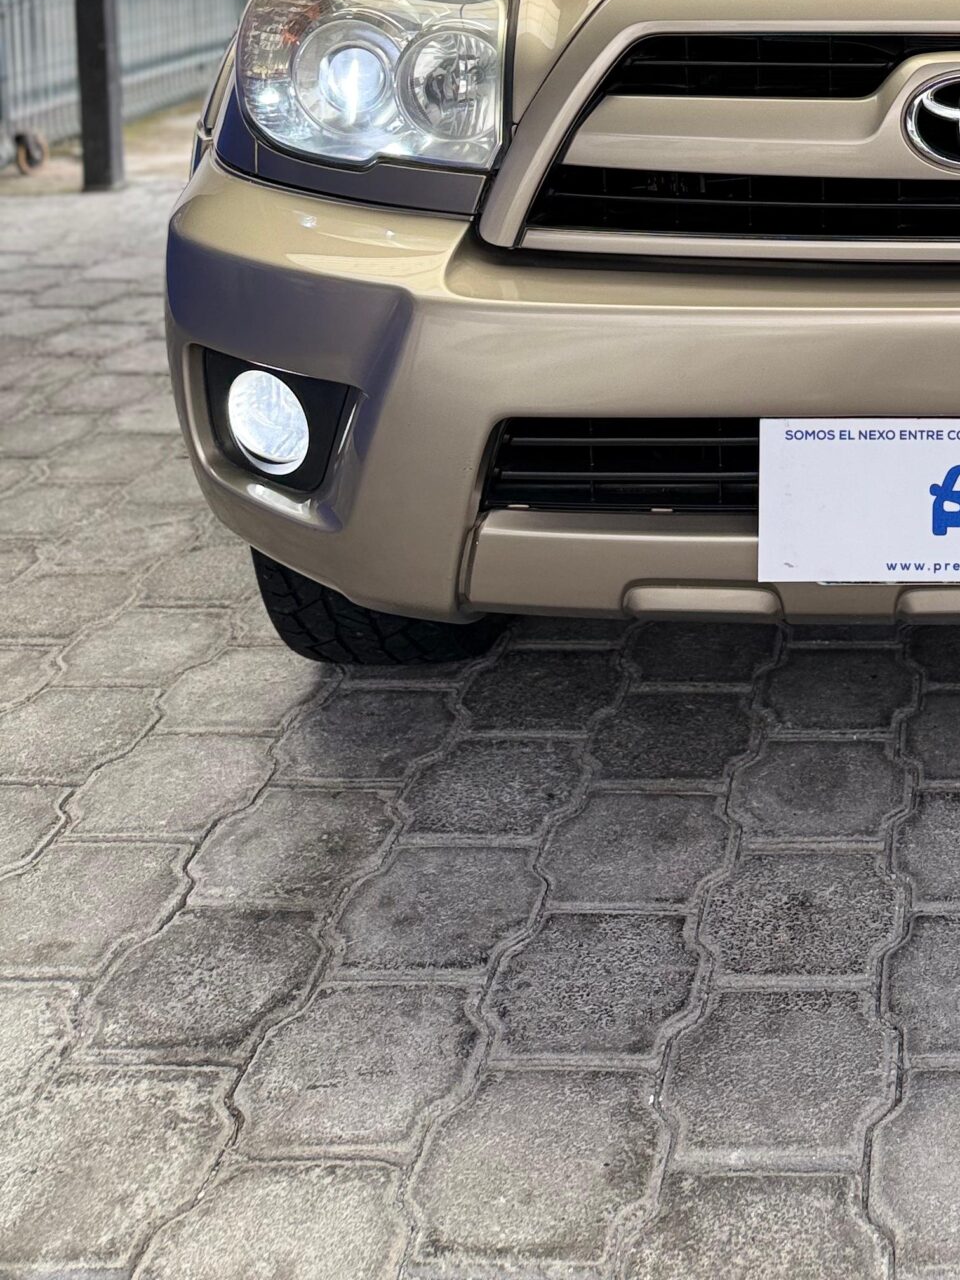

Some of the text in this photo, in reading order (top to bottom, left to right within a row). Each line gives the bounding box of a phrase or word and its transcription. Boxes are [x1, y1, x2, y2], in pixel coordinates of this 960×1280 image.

[784, 429, 836, 441] SOMOS
[839, 429, 855, 441] EL
[858, 429, 896, 441] NEXO
[899, 429, 944, 441] ENTRE
